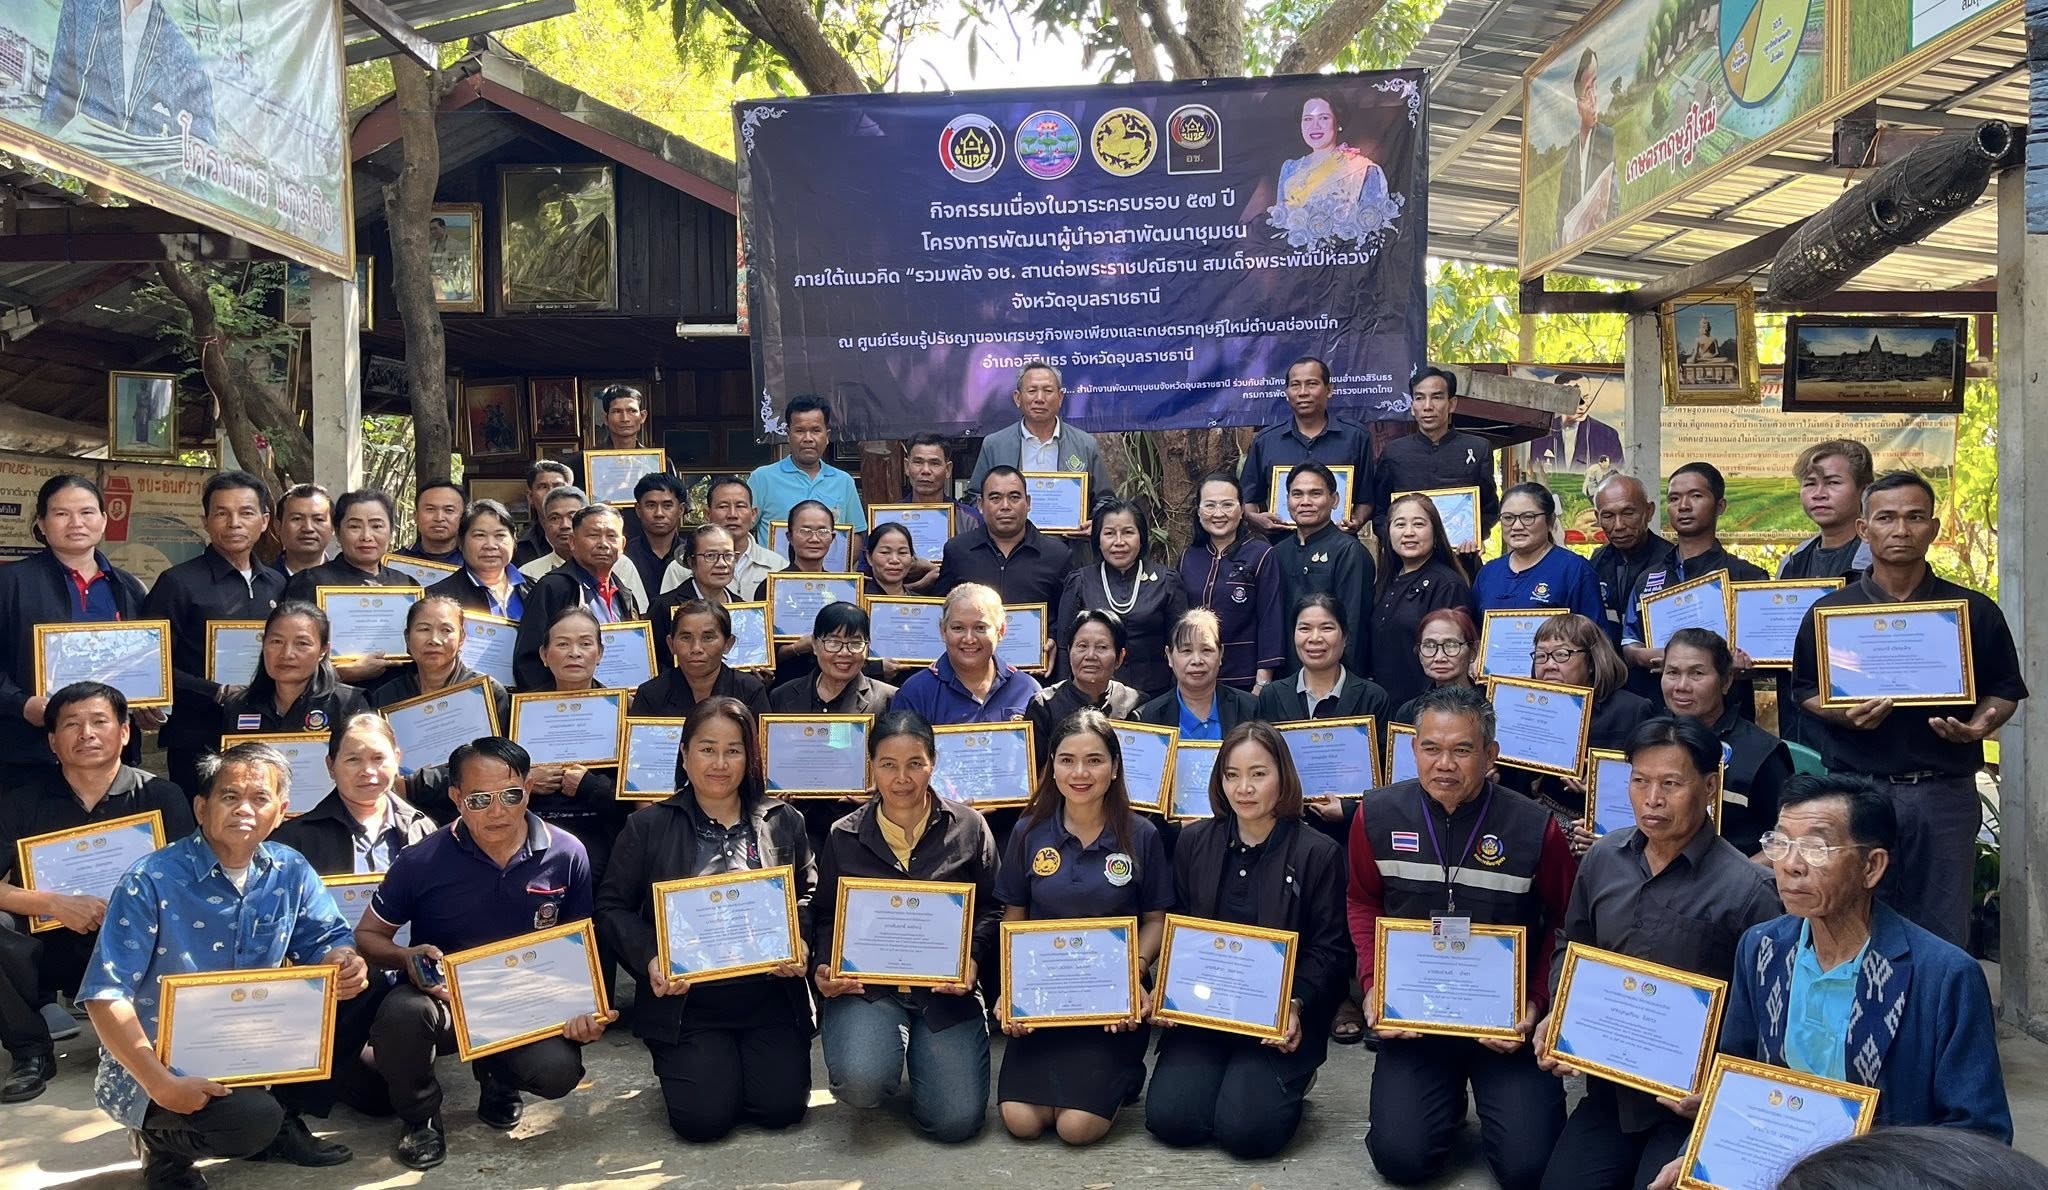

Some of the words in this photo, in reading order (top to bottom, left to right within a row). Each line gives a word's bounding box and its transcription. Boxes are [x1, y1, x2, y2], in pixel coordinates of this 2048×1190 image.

[1626, 96, 1716, 184] เกษตรทฤษฎีใหม่
[178, 111, 268, 207] โครงการ
[930, 192, 1179, 219] กิจกรรมเนื่องในวาระครบรอบ
[1187, 193, 1215, 208] ๕๗
[1221, 187, 1235, 207] ปี
[921, 223, 1247, 252] โครงการพัฒนาผู้นำอาสาพัฒนาชุมชน
[794, 267, 900, 287] ภายใต้แนวคิด
[906, 264, 983, 283] “รวมพลัง
[987, 267, 1016, 280] อช.
[1021, 257, 1197, 279] สานต่อพระราชปณิธาน
[1011, 287, 1160, 312] จังหวัดอุบลราชธานี
[838, 337, 853, 349] ณ
[857, 314, 1339, 351] ศูนย์เรียนรู้ปรัชญาของเศรษฐกิจพอเพียงและเกษตรทฤษฎีใหม่ตำบลช่องเม็ก
[1072, 346, 1194, 368] จังหวัดอุบลราชธานี
[1077, 379, 1231, 394] สำนักงานพัฒนาชุมชนจังหวัดอุบลราชธานี
[0, 462, 32, 475] กขยะ
